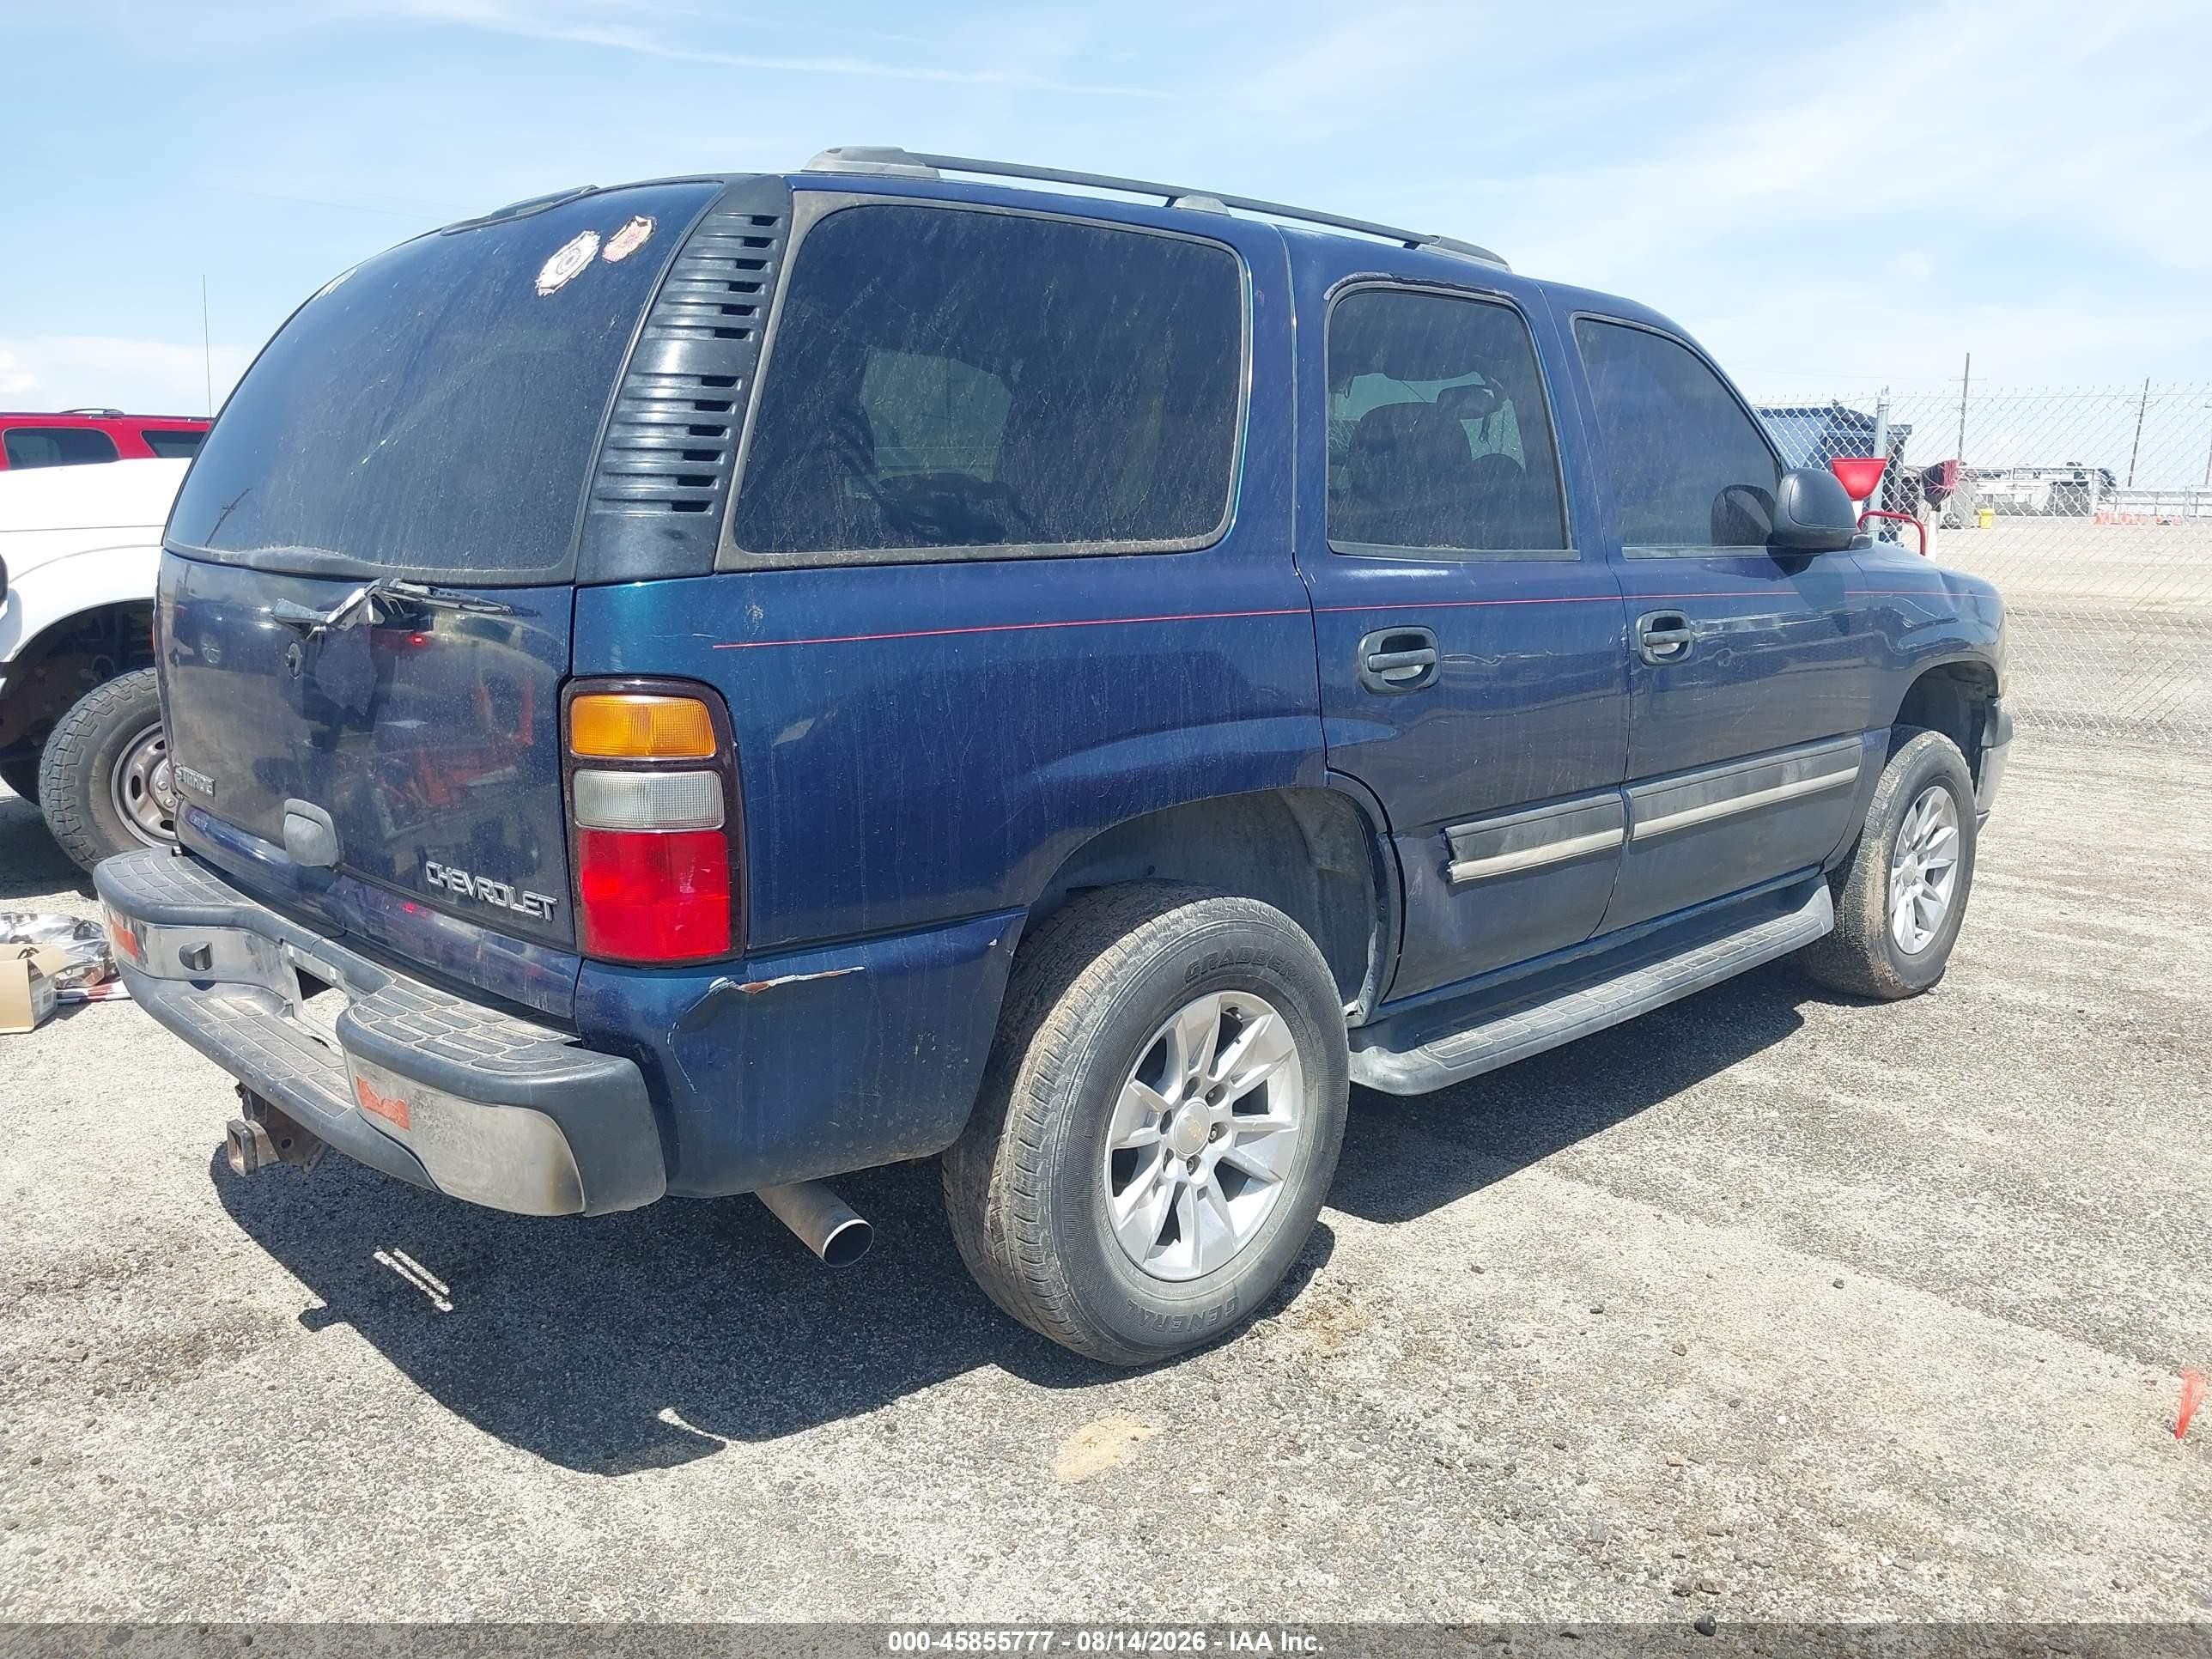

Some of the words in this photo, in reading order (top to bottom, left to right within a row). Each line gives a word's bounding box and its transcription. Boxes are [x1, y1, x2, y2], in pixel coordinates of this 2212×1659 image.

[426, 860, 557, 921] CHEVROLET
[1184, 945, 1299, 984] GRABBER
[1126, 1295, 1239, 1333] GENERAL
